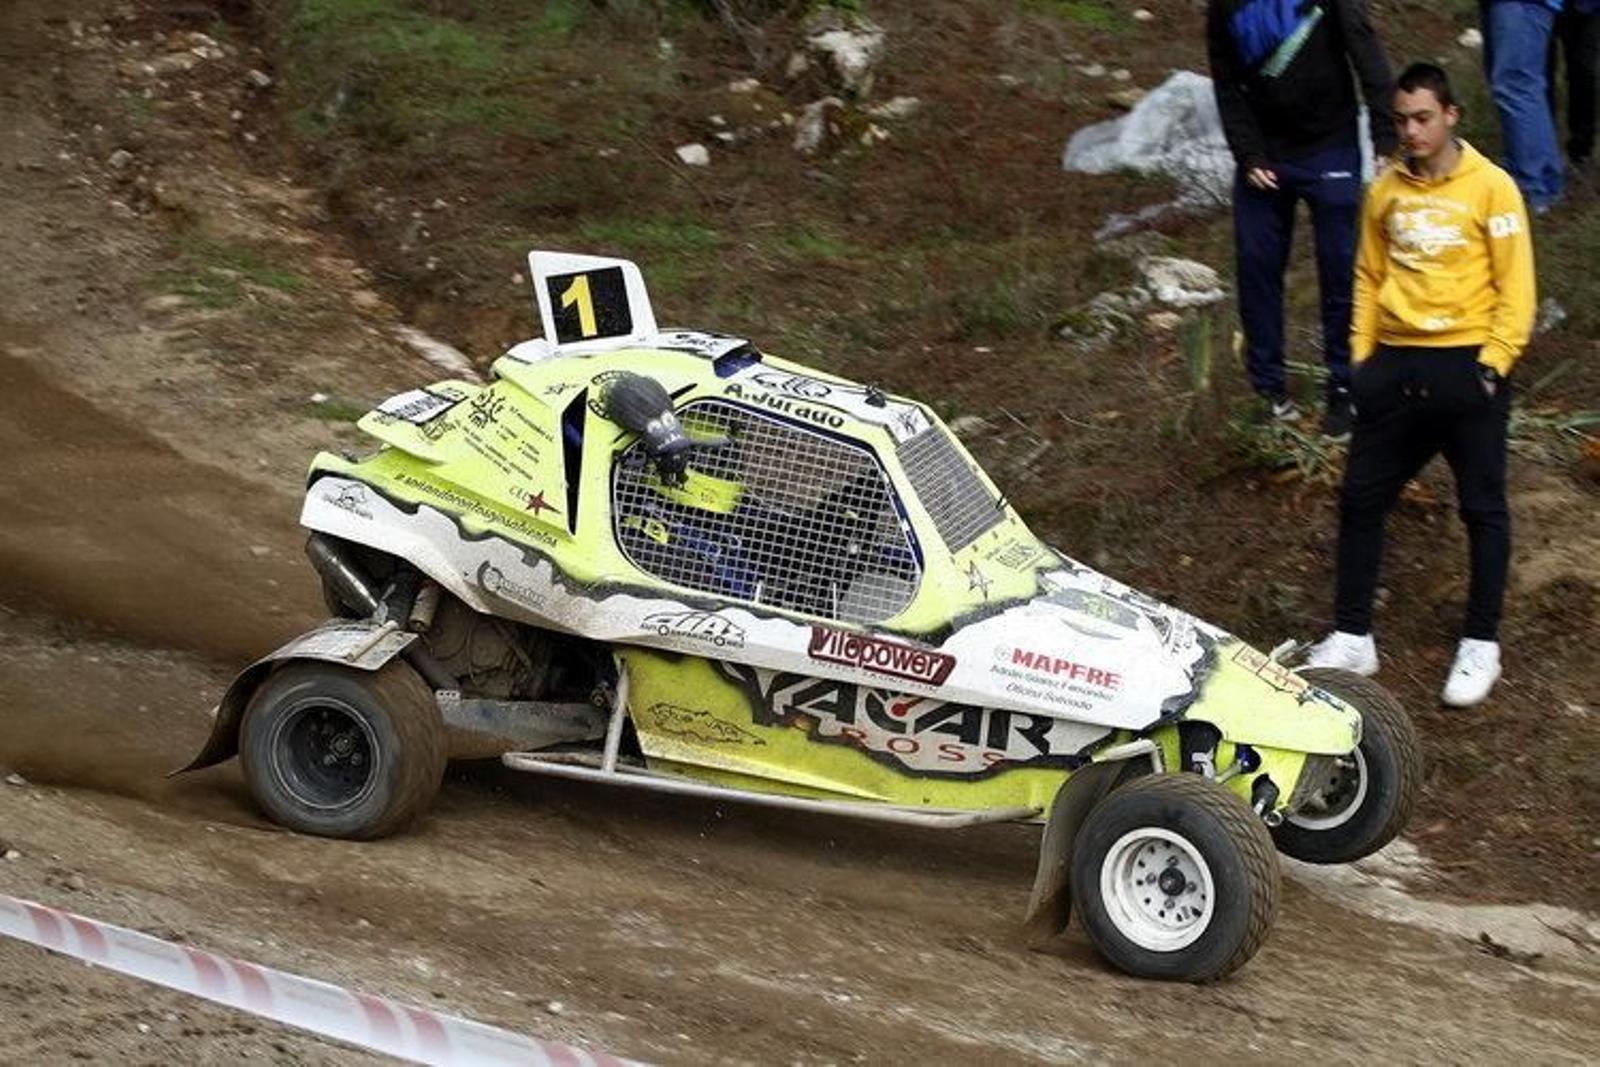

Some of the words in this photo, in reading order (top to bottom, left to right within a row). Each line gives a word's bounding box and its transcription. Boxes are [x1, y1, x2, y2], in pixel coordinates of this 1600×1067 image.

[562, 273, 598, 338] 1
[724, 383, 845, 428] A.Jurado
[1012, 647, 1123, 690] MAPFRE
